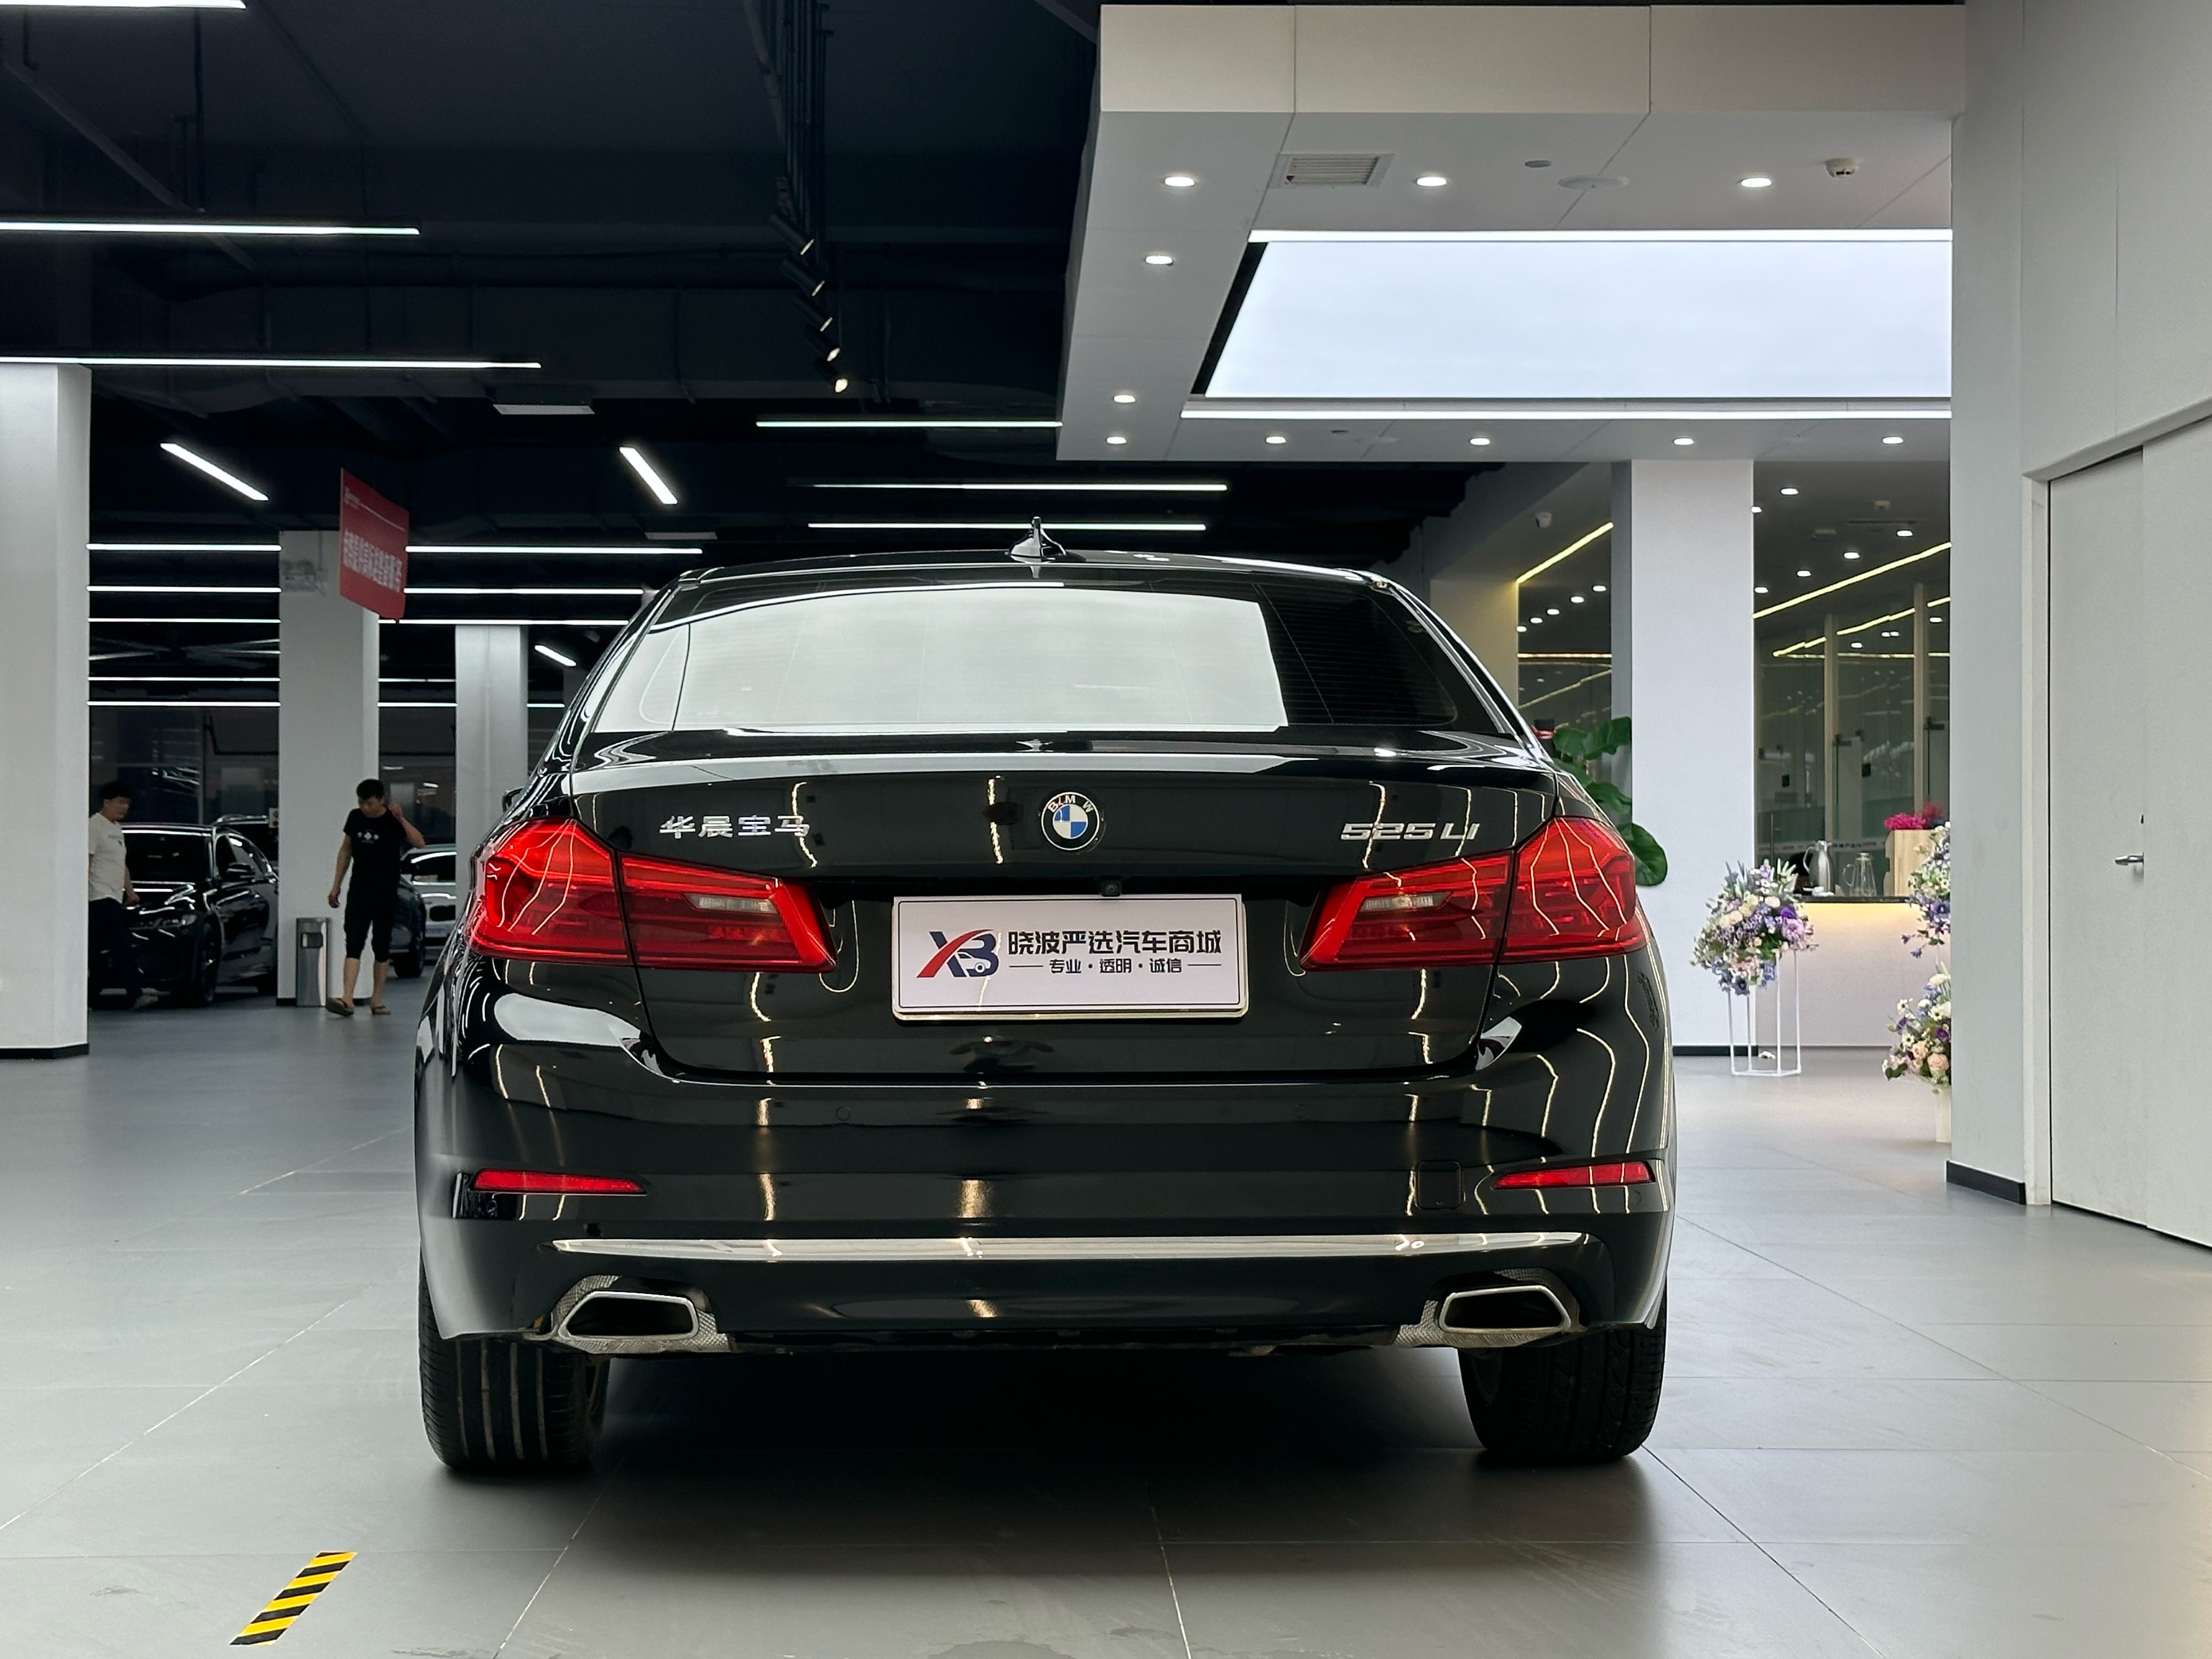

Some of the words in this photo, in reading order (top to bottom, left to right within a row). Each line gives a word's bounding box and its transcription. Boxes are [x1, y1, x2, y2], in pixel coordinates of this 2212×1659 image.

[1048, 795, 1094, 813] BMW
[659, 815, 810, 839] 华晨宝马
[1008, 930, 1222, 955] 晓波严选汽车商城
